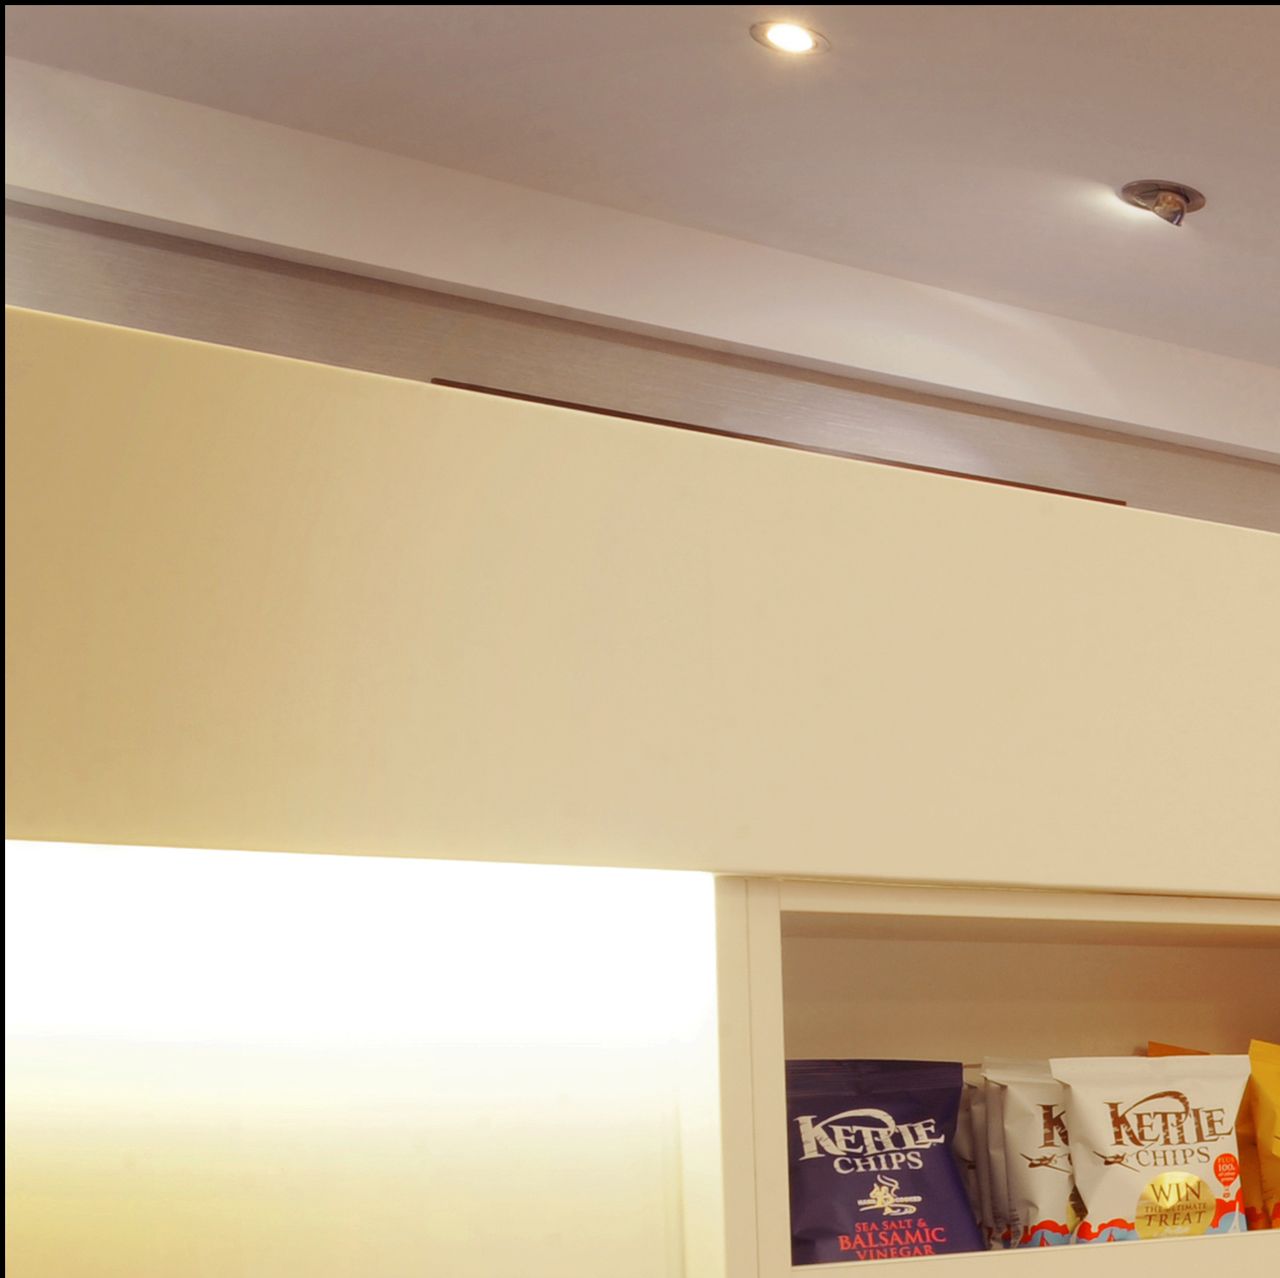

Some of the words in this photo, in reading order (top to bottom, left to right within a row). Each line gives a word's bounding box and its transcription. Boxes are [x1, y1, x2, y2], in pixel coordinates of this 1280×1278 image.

[1103, 1090, 1234, 1147] KETTLE
[793, 1108, 945, 1161] KETTLE
[833, 1151, 924, 1174] CHIPS
[1134, 1146, 1211, 1167] CHIPS
[1151, 1182, 1201, 1202] WIN
[855, 1221, 879, 1233] SEA
[884, 1219, 913, 1231] SALT
[917, 1218, 928, 1229] &
[1144, 1211, 1207, 1227] TREAT
[838, 1227, 947, 1251] BALSAMIC
[856, 1245, 936, 1261] VINEGAR
